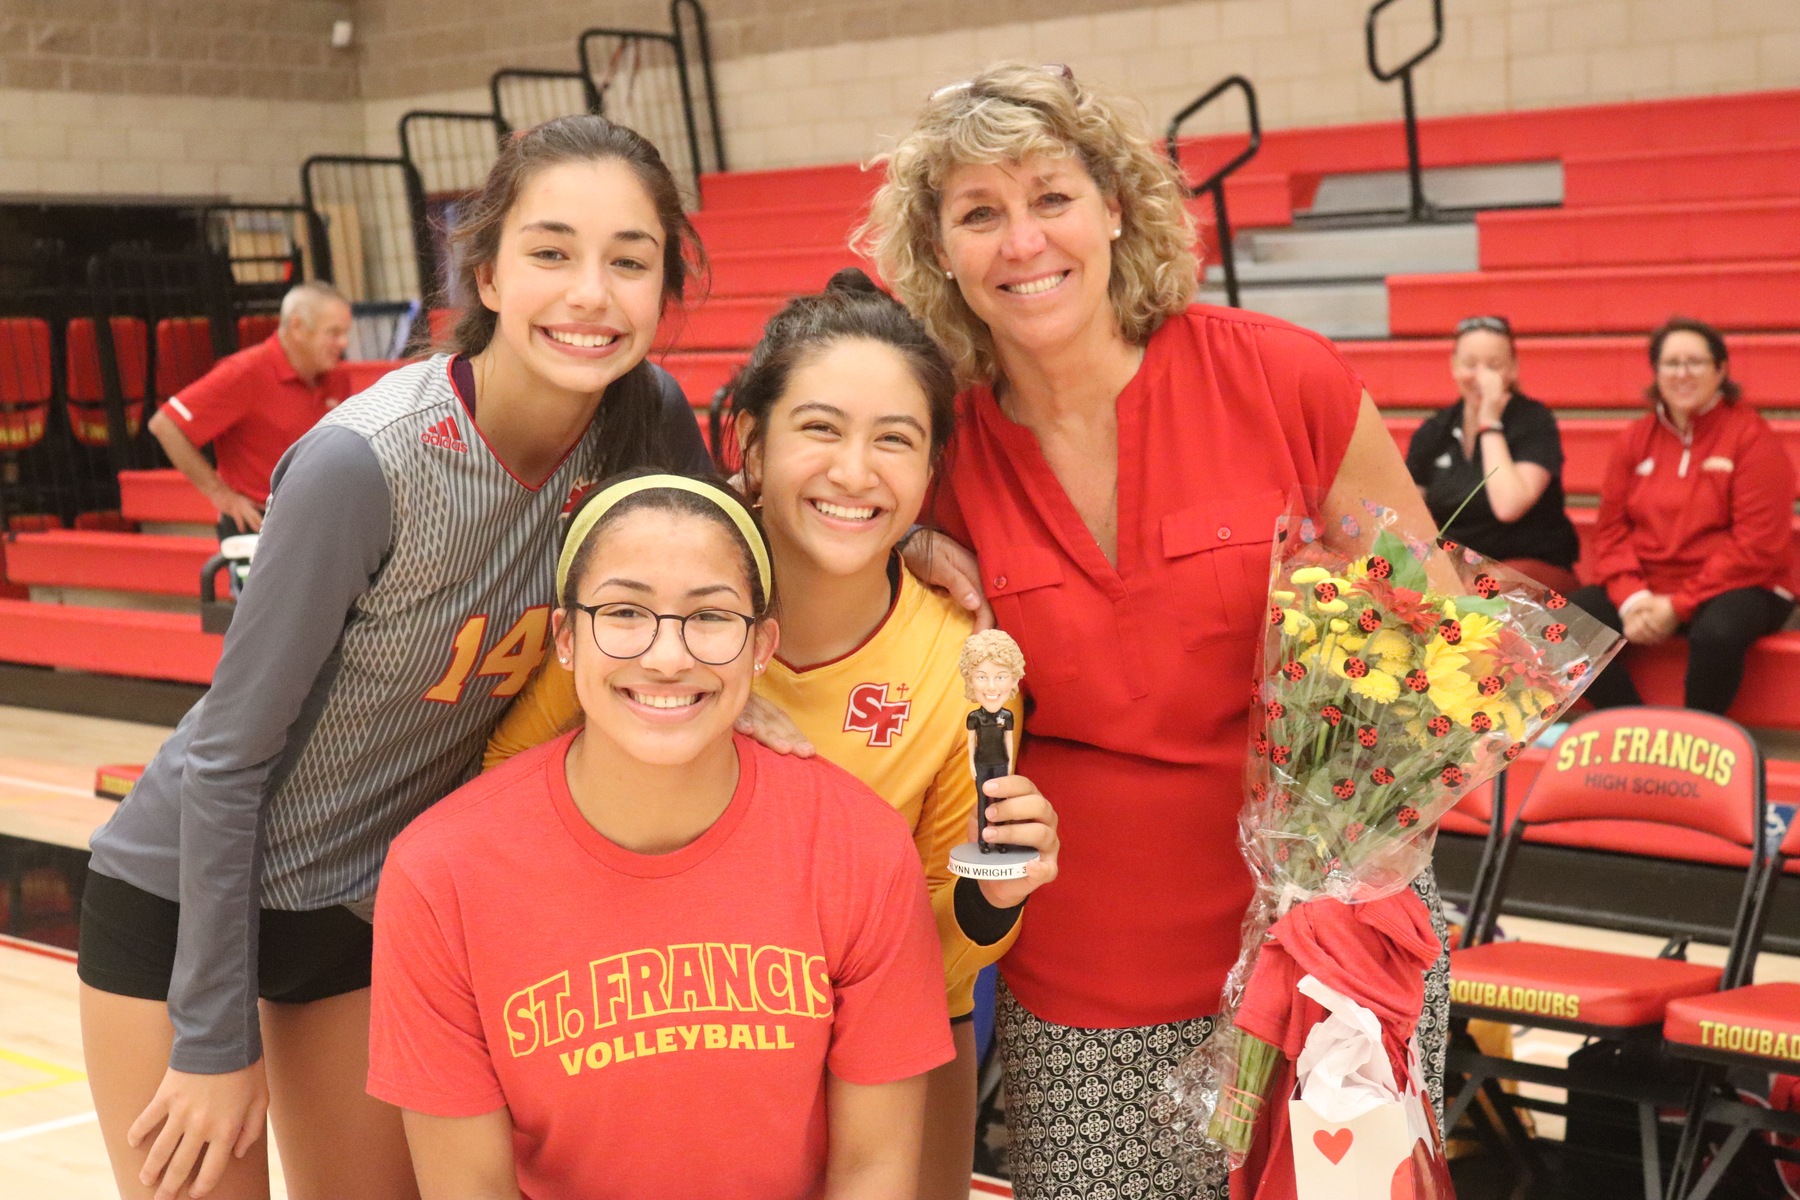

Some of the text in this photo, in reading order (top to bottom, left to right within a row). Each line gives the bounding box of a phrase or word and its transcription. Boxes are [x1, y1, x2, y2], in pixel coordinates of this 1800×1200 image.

[420, 431, 468, 454] adidas
[421, 603, 551, 705] 14
[842, 682, 912, 747] SF
[1556, 726, 1737, 787] ST. FRANCIS
[1584, 772, 1700, 798] HIGH SCHOOL
[973, 867, 1014, 877] WRIGHT
[503, 942, 834, 1058] ST. FRANCIS
[558, 1023, 795, 1077] VOLLEYBALL
